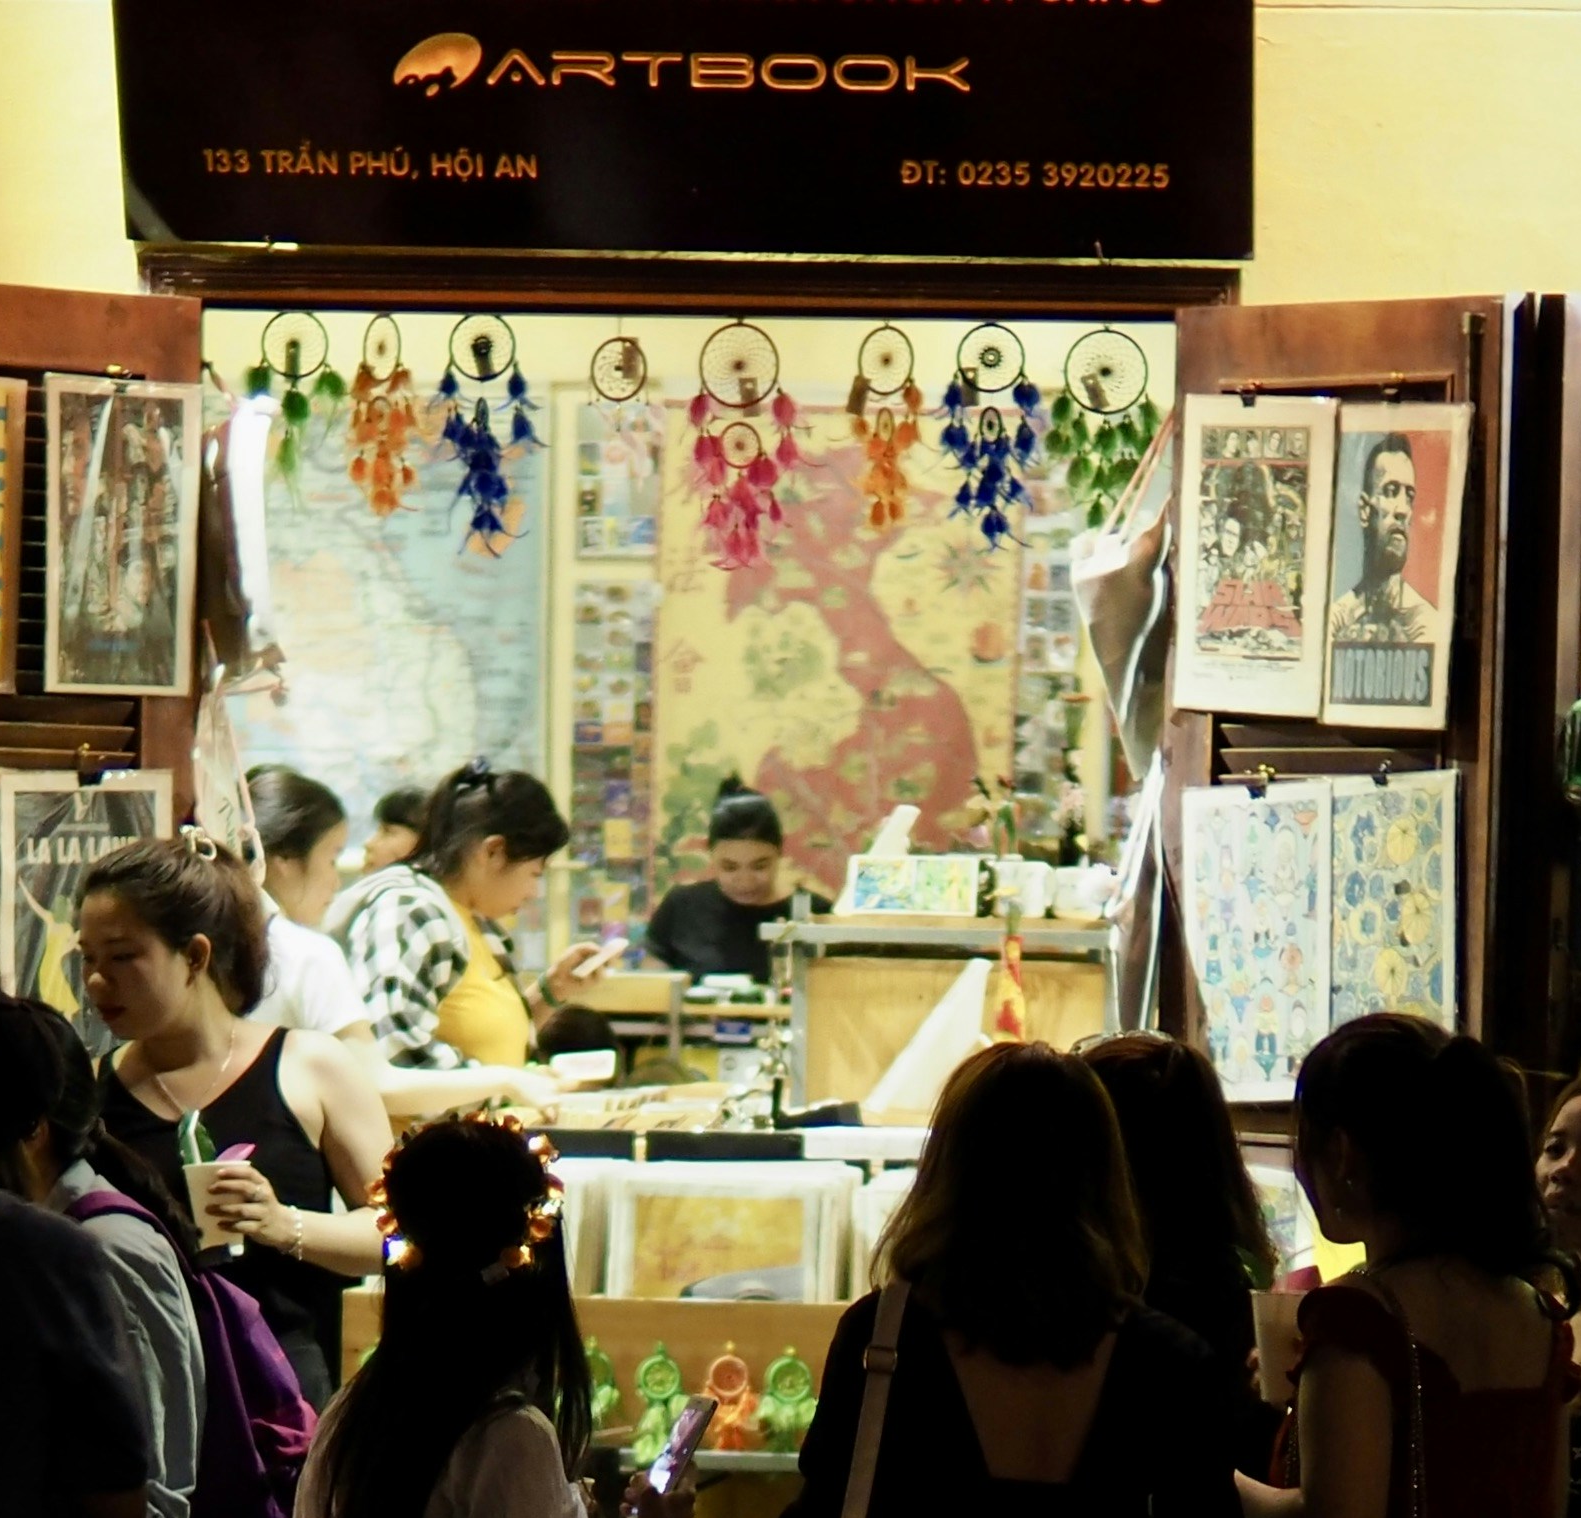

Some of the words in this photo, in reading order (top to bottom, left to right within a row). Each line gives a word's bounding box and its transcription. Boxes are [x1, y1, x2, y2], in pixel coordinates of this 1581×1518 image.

[488, 48, 971, 92] ARTBOOK
[202, 148, 251, 175] 133
[349, 145, 422, 181] PHÚ,
[431, 146, 485, 183] HỘI
[493, 153, 539, 179] AN
[900, 159, 947, 186] ĐT:
[958, 161, 1032, 187] 0235
[1043, 162, 1171, 189] 3920225
[1332, 648, 1431, 702] NOTORIOUS
[26, 836, 52, 865] LA
[57, 836, 83, 865] LA
